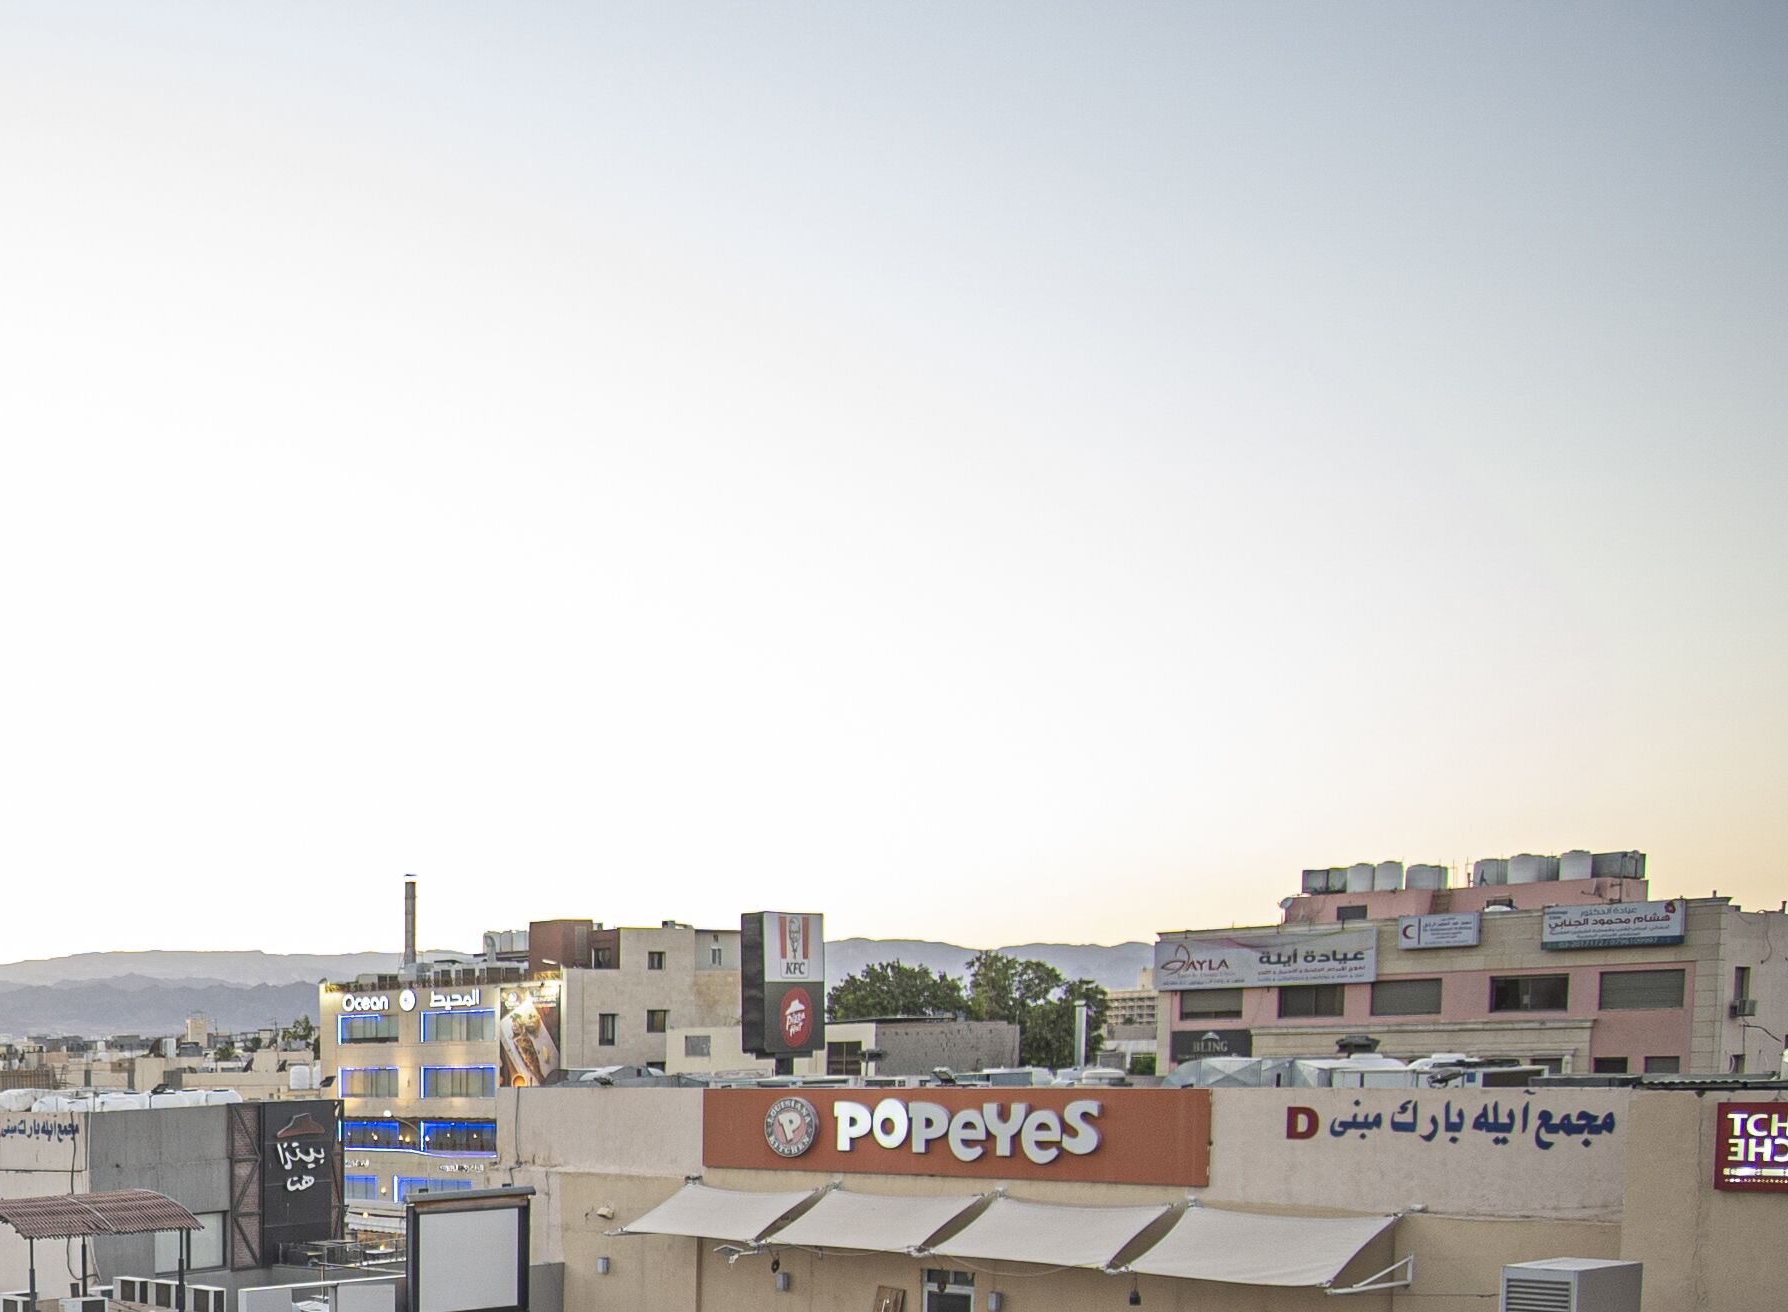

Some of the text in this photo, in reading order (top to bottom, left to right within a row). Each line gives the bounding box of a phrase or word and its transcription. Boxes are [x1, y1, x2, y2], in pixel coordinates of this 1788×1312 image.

[1592, 917, 1630, 926] محمود
[1189, 958, 1229, 971] AYLA
[1303, 949, 1365, 964] عيادة
[785, 962, 805, 975] KFC
[342, 994, 389, 1012] Ocean
[429, 988, 480, 1010] المحيط
[1286, 1106, 1319, 1140] D
[1390, 1100, 1465, 1142] بارك
[1535, 1109, 1616, 1150] مجمع
[277, 1142, 325, 1170] بيتزا
[286, 1175, 315, 1192] هت
